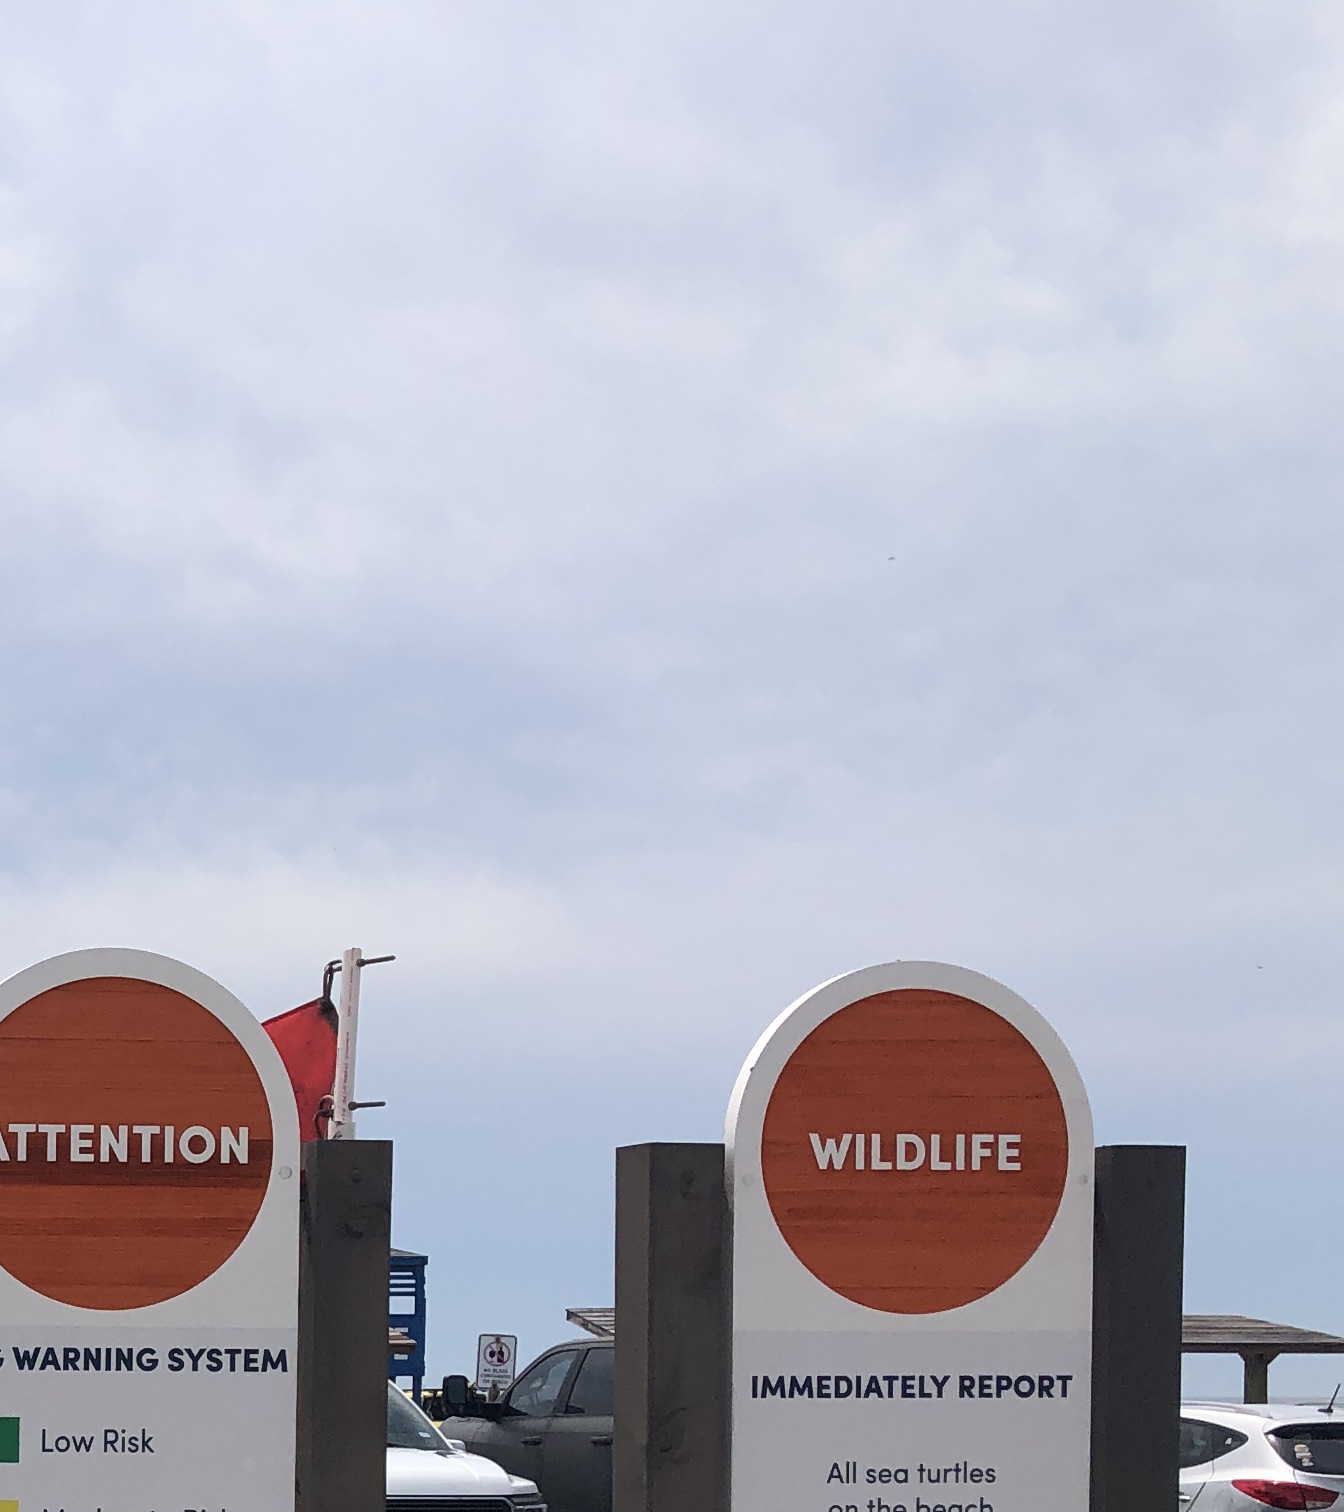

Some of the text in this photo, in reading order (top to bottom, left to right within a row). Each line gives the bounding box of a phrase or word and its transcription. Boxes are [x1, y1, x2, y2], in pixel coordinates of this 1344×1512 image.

[808, 1132, 1022, 1171] WILDLIFE
[11, 1346, 160, 1372] WARNING
[167, 1347, 289, 1373] SYSTEM
[751, 1374, 1074, 1399] IMMEDIATELY REPORT
[41, 1428, 155, 1454] Low Risk
[826, 1460, 997, 1485] All sea turtles
